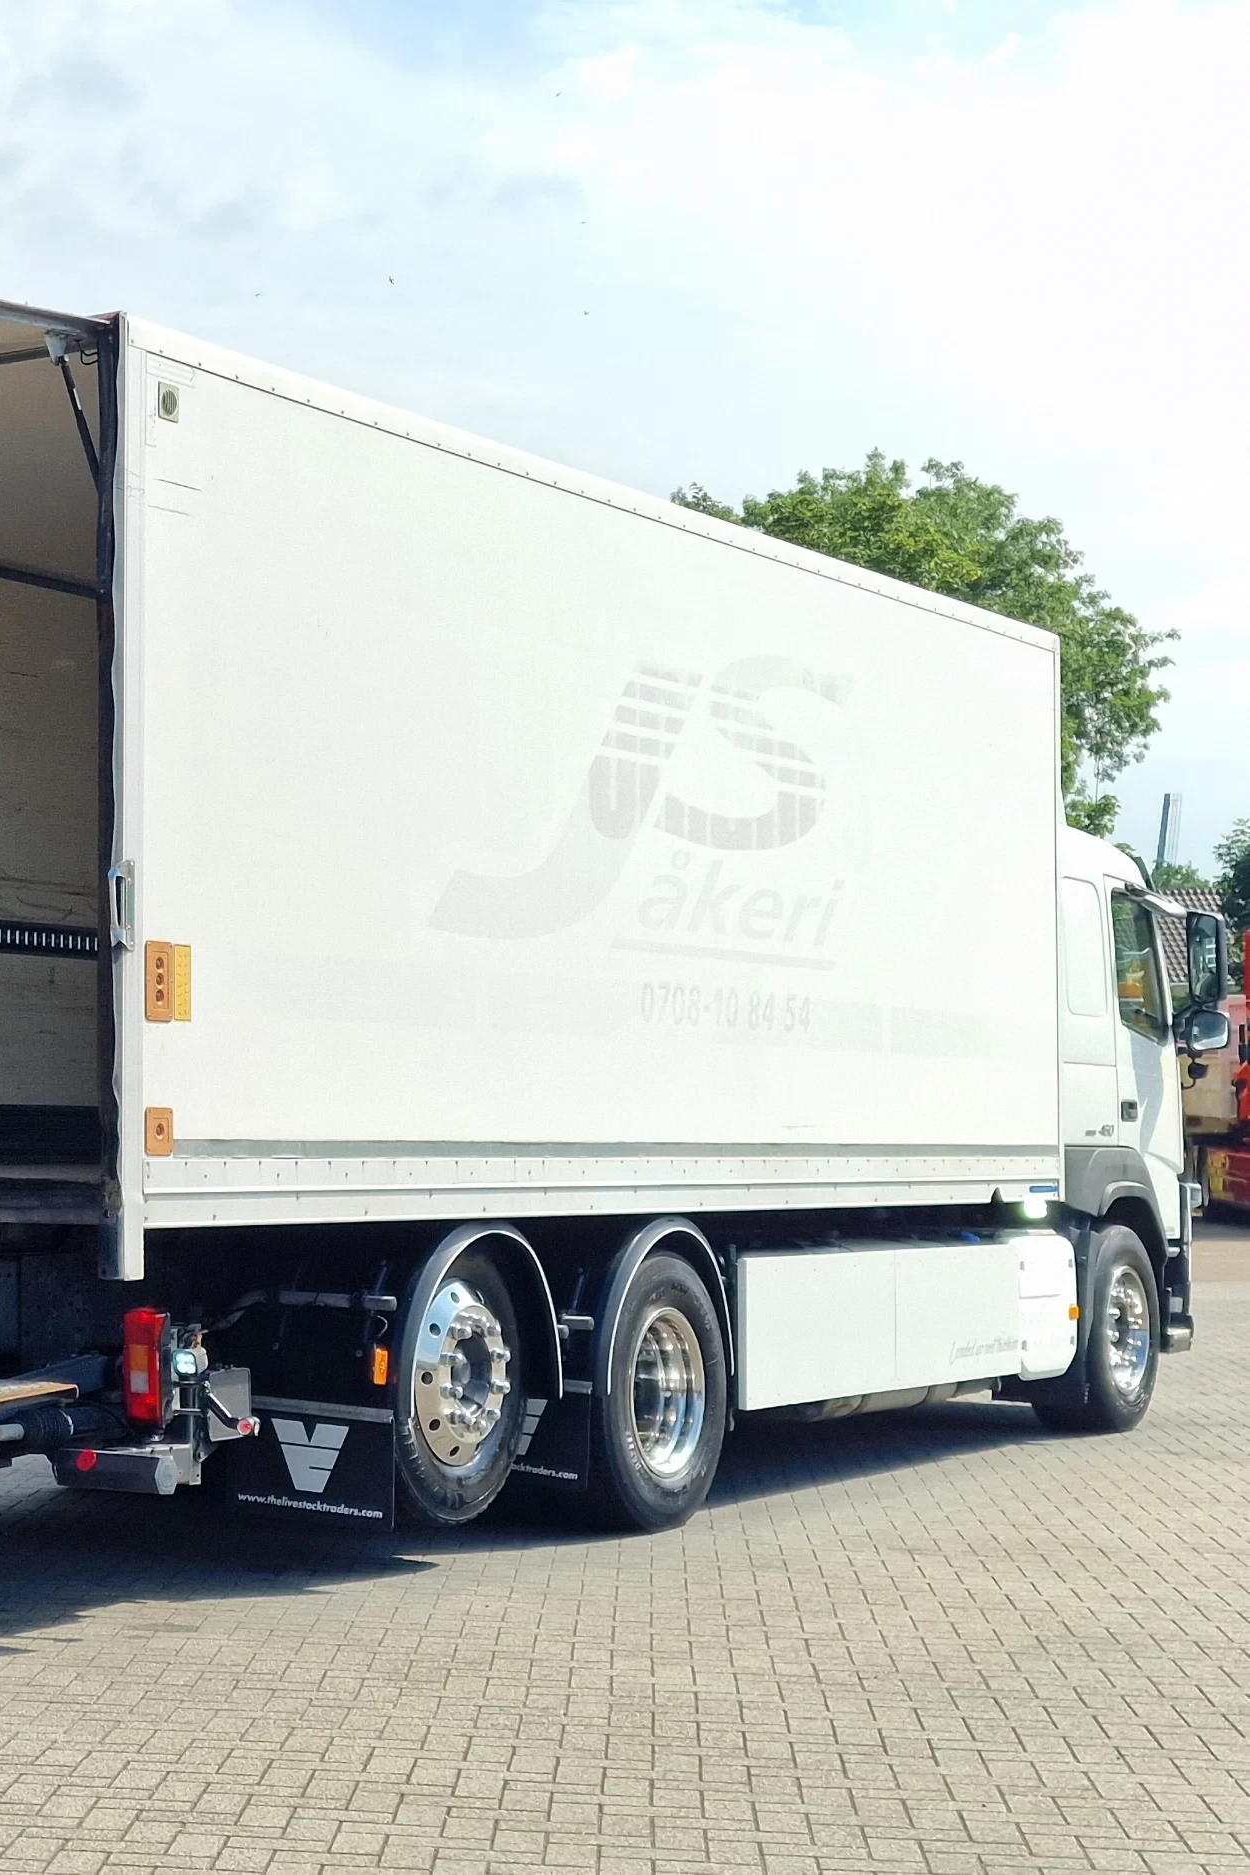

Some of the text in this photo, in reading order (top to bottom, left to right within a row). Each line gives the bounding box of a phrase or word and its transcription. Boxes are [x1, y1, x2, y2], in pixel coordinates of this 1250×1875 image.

[636, 850, 845, 946] åkeri
[640, 981, 811, 1033] 0708-10 84 54
[237, 1492, 383, 1519] www.thelivestocktraders.com
